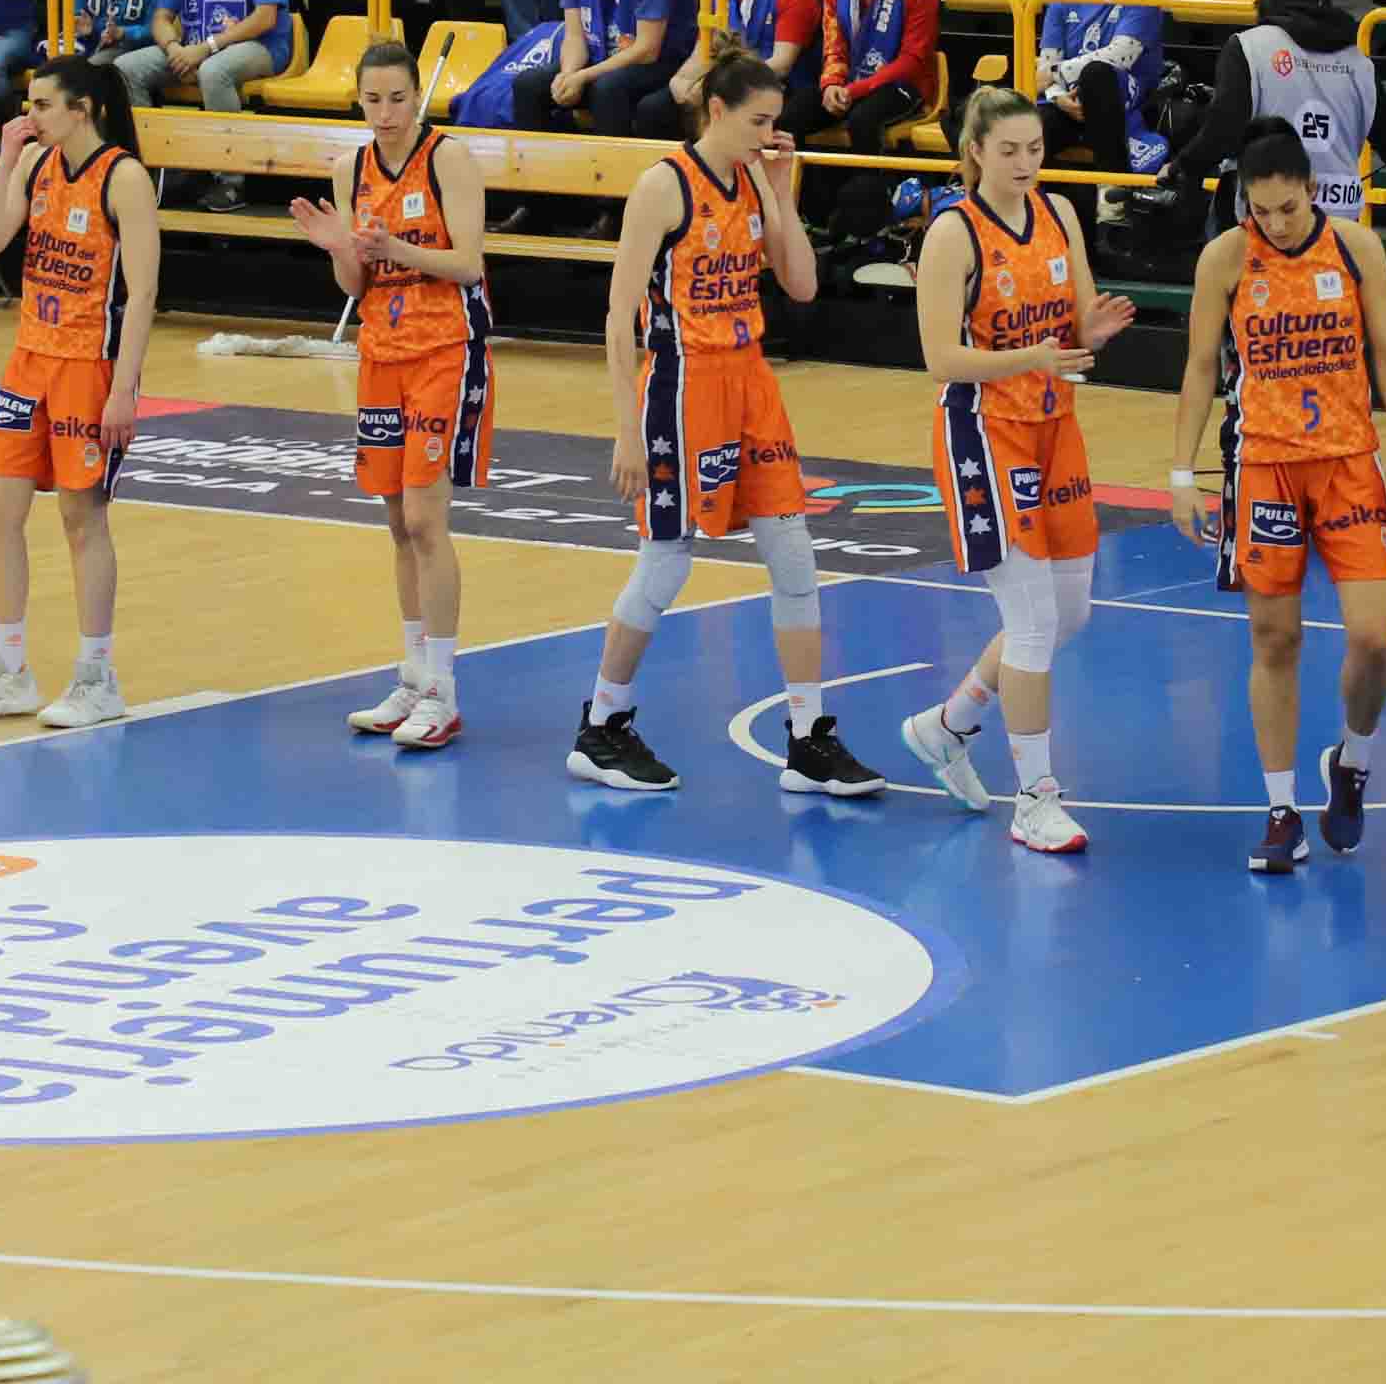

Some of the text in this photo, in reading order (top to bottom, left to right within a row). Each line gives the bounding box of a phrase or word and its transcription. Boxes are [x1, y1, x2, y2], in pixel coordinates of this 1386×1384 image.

[1302, 111, 1330, 140] 25
[35, 292, 61, 325] 10
[388, 295, 406, 329] 9
[991, 297, 1066, 332] Cultura
[1245, 310, 1338, 337] Cultura
[1247, 334, 1356, 366] Esfuerzo
[1301, 386, 1321, 433] 5
